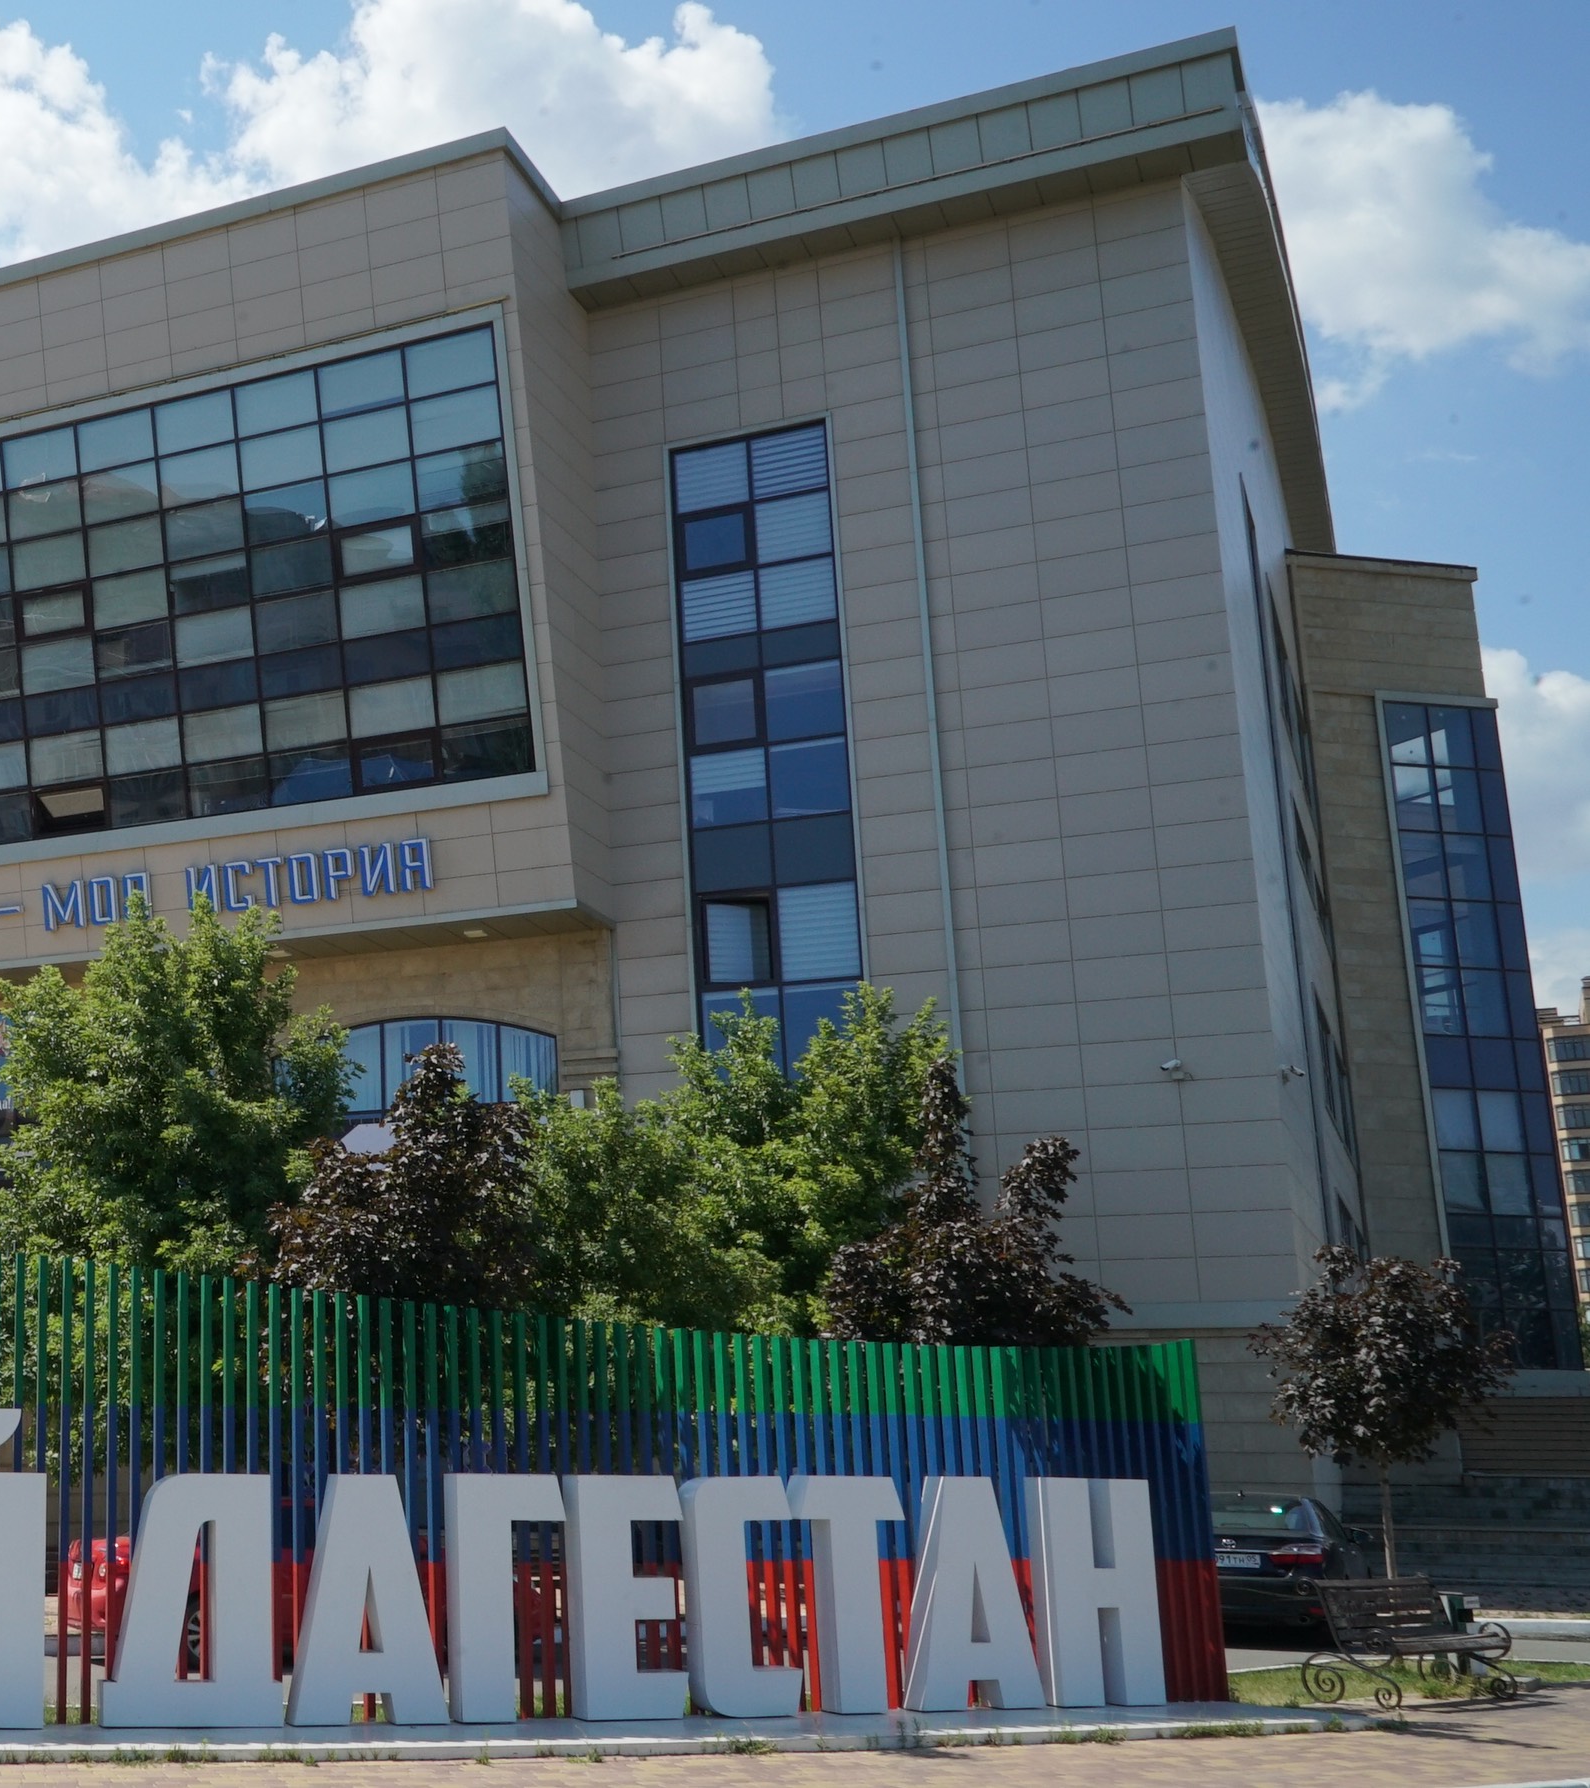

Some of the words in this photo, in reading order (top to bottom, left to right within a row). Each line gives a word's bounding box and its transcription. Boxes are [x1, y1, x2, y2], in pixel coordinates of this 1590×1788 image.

[42, 871, 155, 932] МОЯ
[185, 837, 435, 913] ИСТОРИЯ
[98, 1472, 1168, 1728] ДАГЕСТАН
